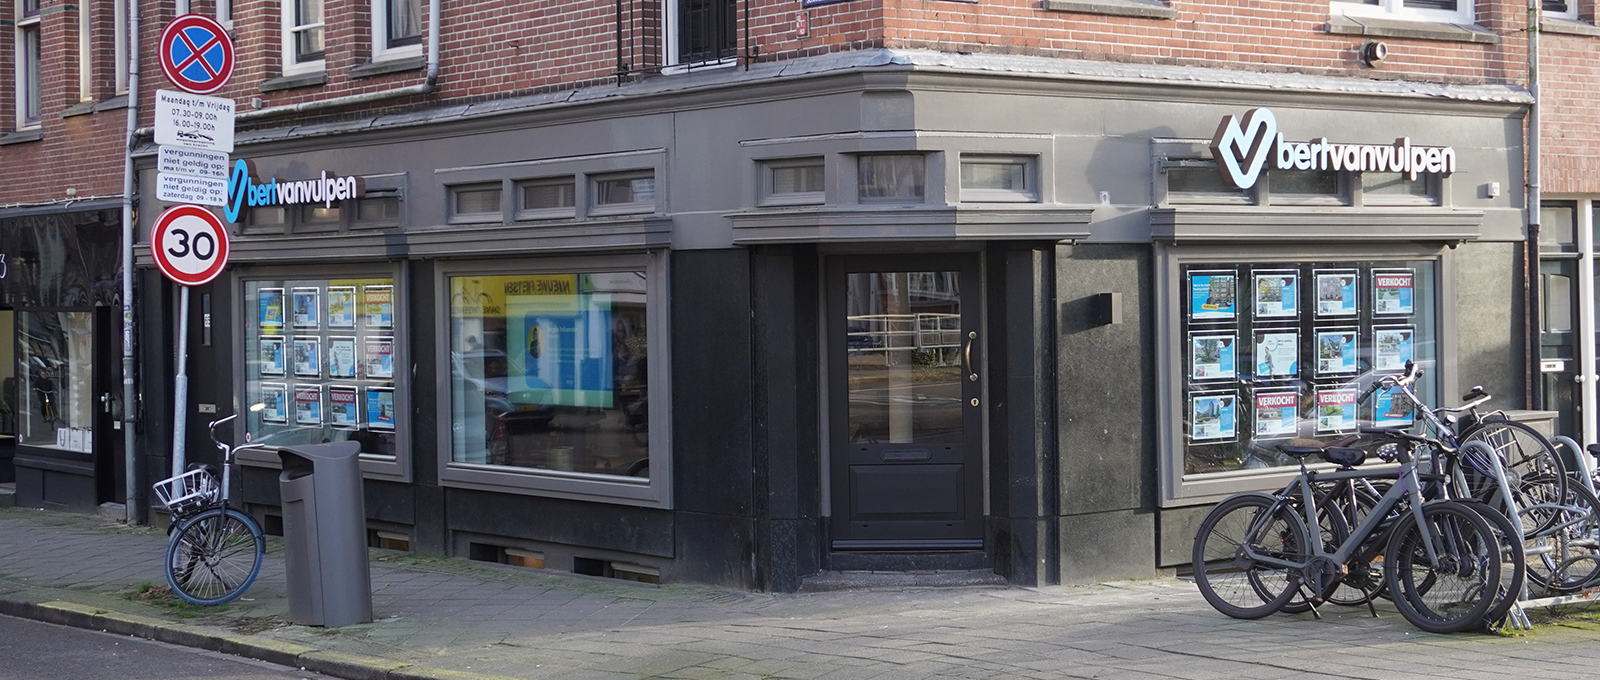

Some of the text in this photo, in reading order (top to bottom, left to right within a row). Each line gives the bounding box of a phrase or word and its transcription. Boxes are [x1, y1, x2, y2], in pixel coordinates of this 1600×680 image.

[161, 95, 230, 112] Maandag t/m Vrijdag
[171, 108, 217, 120] 07.30-09.00h
[173, 119, 215, 131] 16.00-19.00h
[164, 148, 225, 161] vergunningen
[1277, 131, 1456, 181] bertvanvulpen
[163, 157, 180, 165] niet
[182, 160, 209, 169] geldig
[163, 176, 224, 187] vergunningen
[181, 185, 207, 195] geldig
[209, 188, 223, 196] op:
[248, 170, 357, 209] bertvanvulpen
[163, 191, 193, 201] zaterdag
[167, 228, 215, 261] 30
[1377, 277, 1412, 286] VERKOCHT
[367, 344, 391, 353] VERKOCHT
[296, 391, 319, 401] VERKOCHT
[331, 392, 354, 402] VERKOCHT
[1258, 395, 1295, 406] VERKOCHT
[1320, 393, 1354, 403] VERKOCHT
